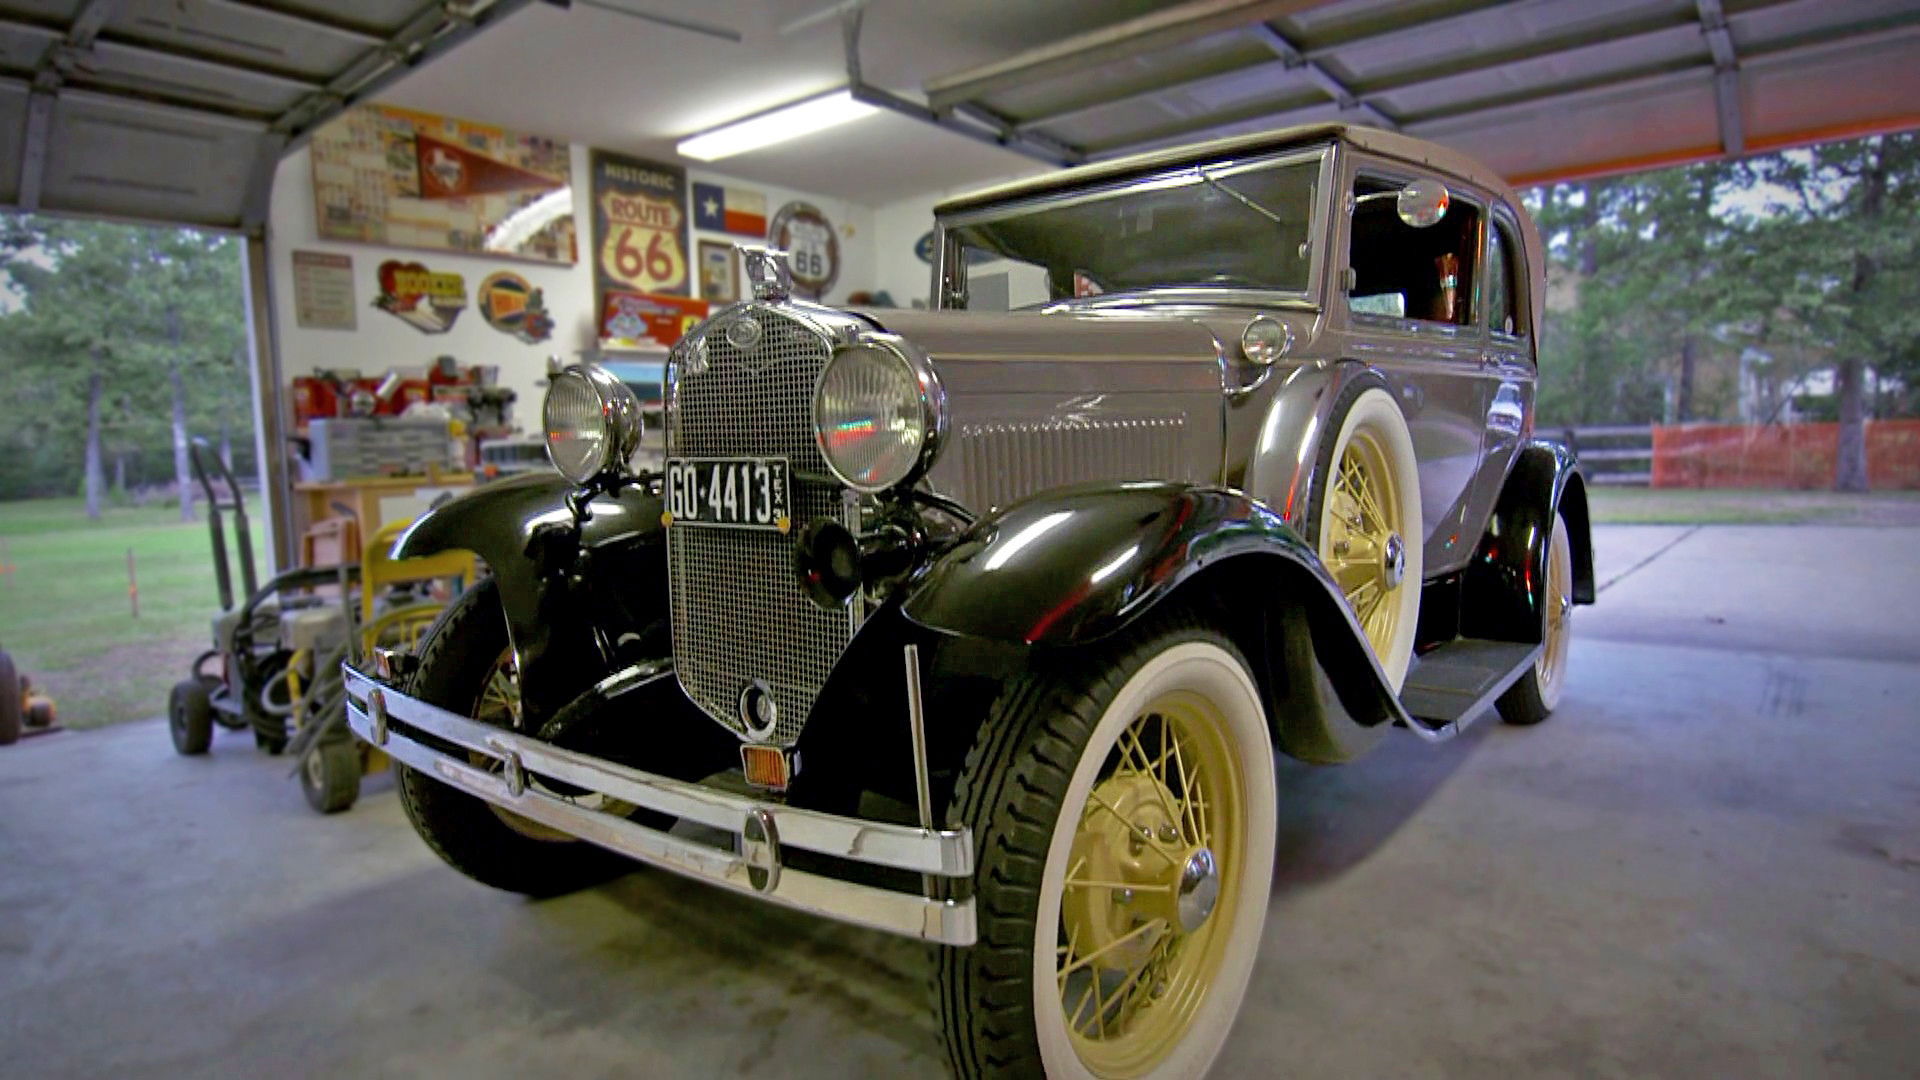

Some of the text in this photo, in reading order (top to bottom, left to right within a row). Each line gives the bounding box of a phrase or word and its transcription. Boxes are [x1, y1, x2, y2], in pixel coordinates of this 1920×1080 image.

[604, 162, 674, 190] HISTORIC
[610, 197, 672, 227] ROUTE
[615, 226, 674, 282] 66
[796, 250, 822, 276] 66
